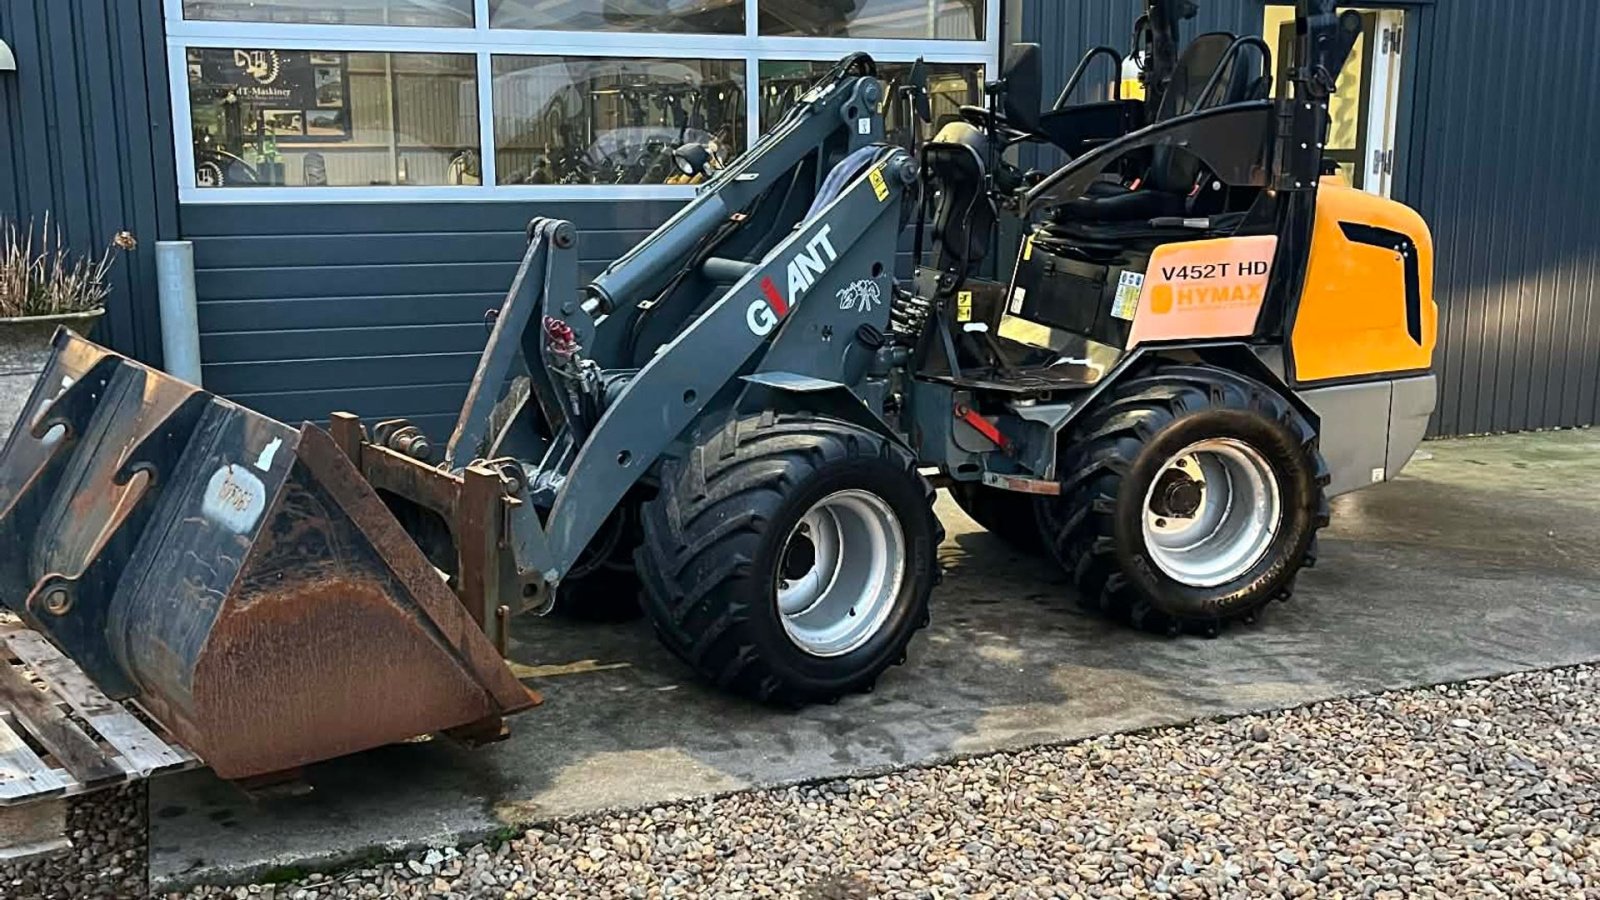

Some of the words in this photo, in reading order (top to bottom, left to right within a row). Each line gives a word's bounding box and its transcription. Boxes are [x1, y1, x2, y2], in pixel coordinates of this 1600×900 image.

[1162, 263, 1231, 281] V452T
[1238, 261, 1268, 276] HD
[1177, 283, 1262, 304] HYMAX
